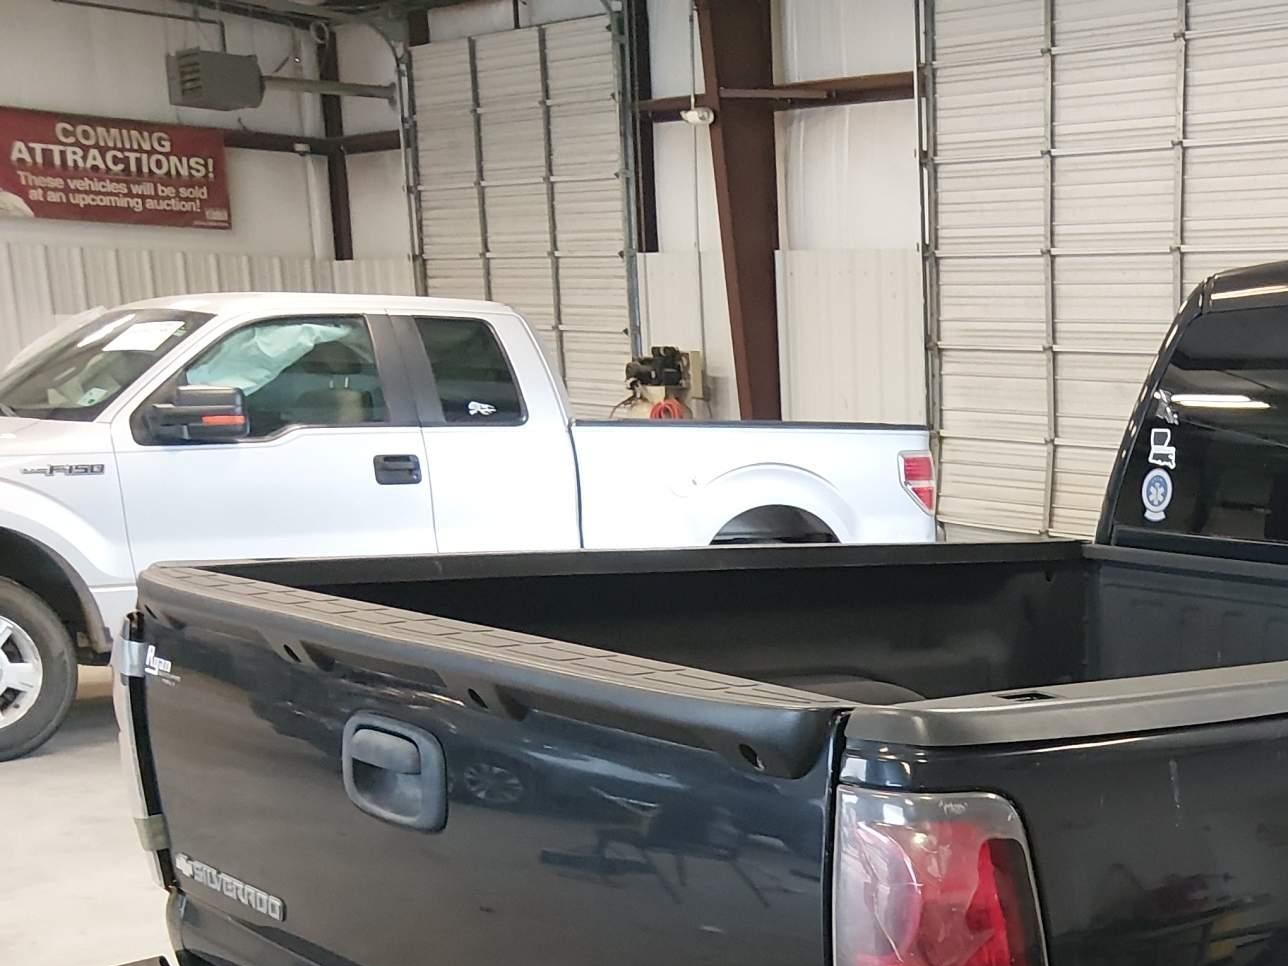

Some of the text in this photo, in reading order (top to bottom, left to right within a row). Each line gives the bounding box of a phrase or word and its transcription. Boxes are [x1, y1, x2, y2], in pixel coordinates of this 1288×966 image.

[55, 121, 171, 153] COMING
[10, 140, 214, 178] ATTRACTIONS!
[17, 171, 208, 199] These vehicles will be sold
[28, 189, 201, 212] at an upcoming auction!
[192, 859, 281, 921] SILVERADO
